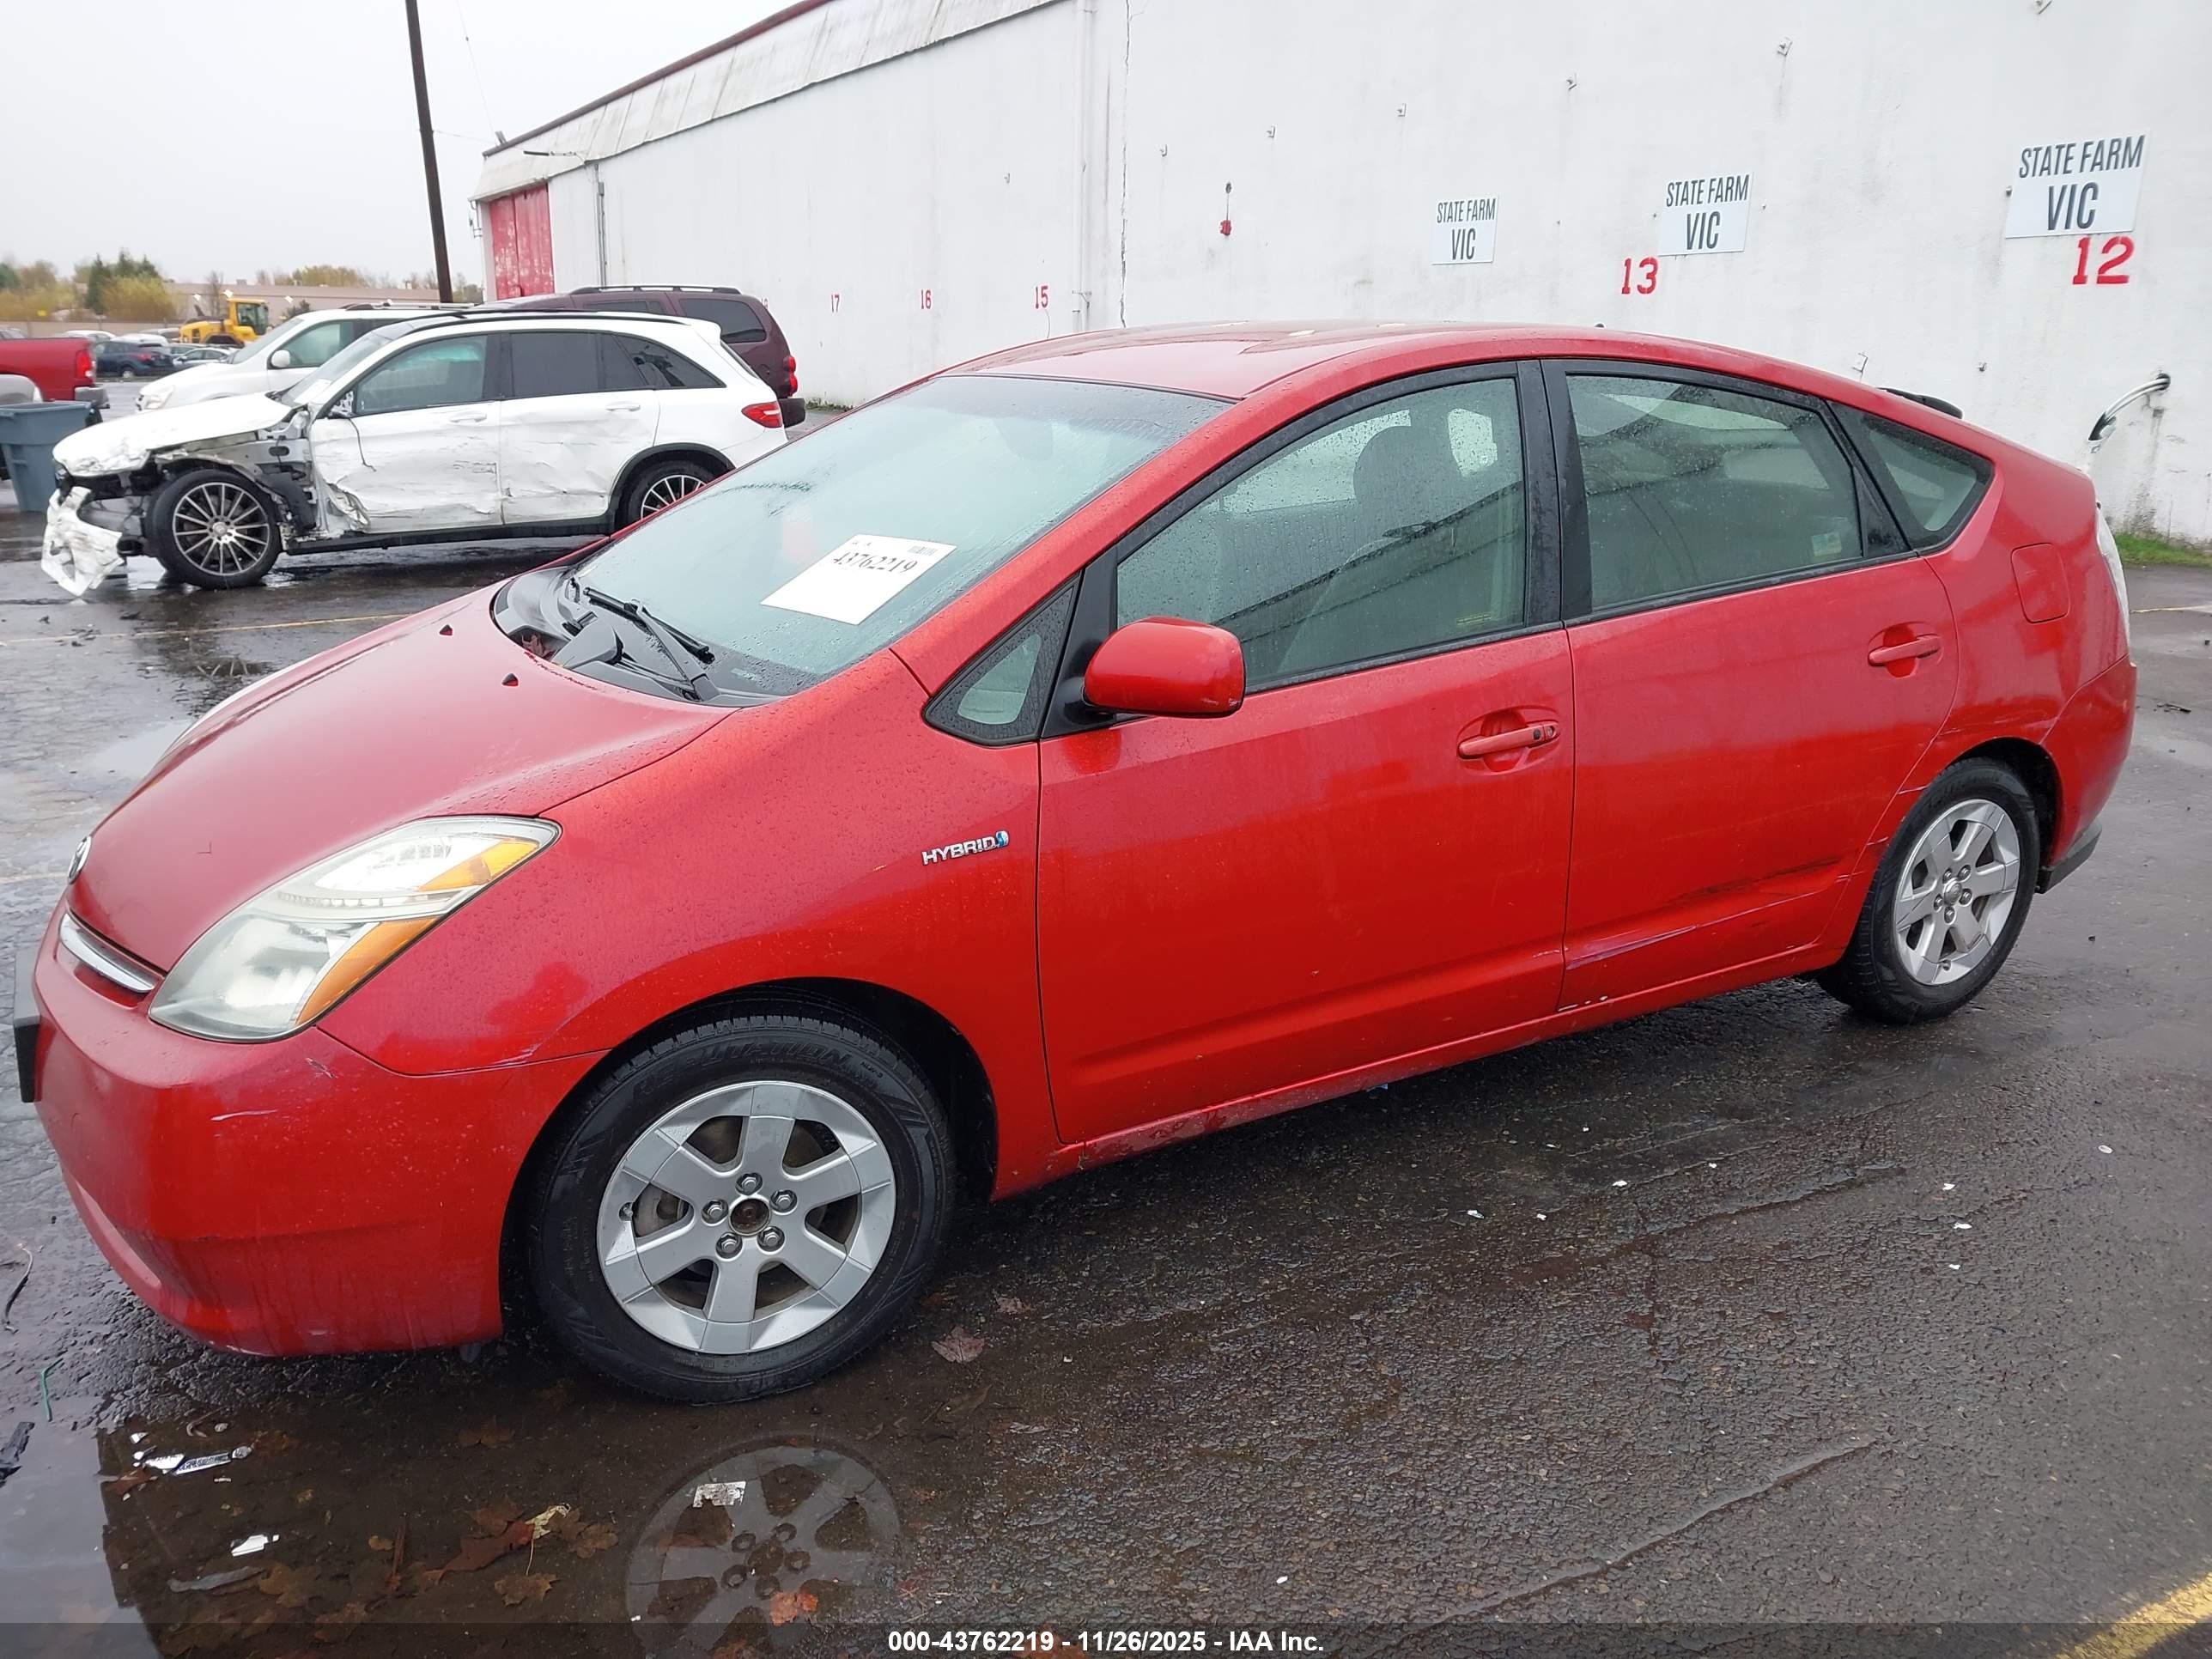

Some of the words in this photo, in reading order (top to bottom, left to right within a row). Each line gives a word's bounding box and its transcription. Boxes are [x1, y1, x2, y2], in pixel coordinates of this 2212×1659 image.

[2019, 143, 2076, 179] STATE
[2079, 135, 2146, 173] FARM
[1666, 179, 1705, 207] STATE
[1707, 174, 1750, 204] FARM
[2047, 182, 2099, 230] VIC
[1437, 200, 1465, 223] STATE
[1465, 198, 1496, 222] FARM
[1452, 228, 1476, 260] VIC
[1686, 211, 1721, 250] VIC
[1621, 257, 1659, 295] 13
[2072, 235, 2135, 285] 12
[831, 295, 840, 313] 17
[921, 289, 932, 309] 16
[1035, 285, 1049, 309] 15
[833, 551, 919, 574] 43762219
[921, 836, 998, 866] HYBRID
